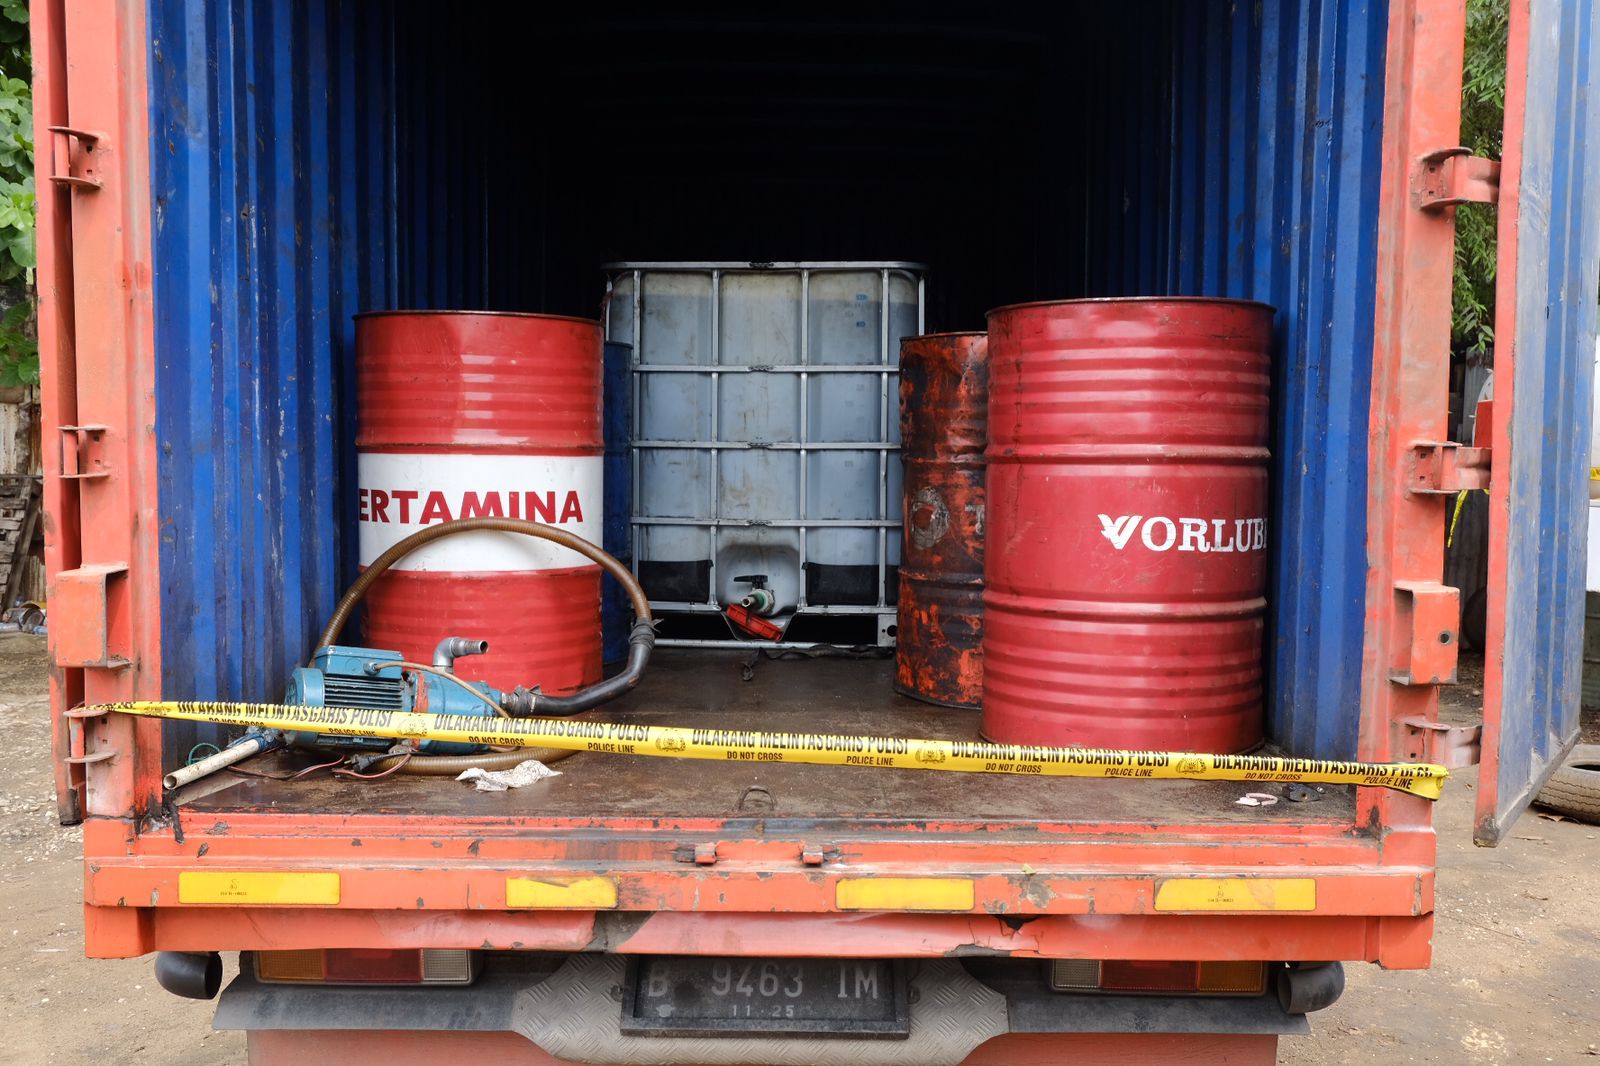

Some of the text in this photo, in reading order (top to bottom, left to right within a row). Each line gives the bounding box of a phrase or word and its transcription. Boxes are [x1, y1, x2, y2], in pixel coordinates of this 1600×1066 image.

[434, 714, 497, 733] DILARANG
[608, 723, 650, 742] POLISI
[468, 735, 525, 746] DO NOT CROSS
[692, 729, 756, 748] DILARANG
[867, 737, 908, 755] POLISI
[588, 742, 635, 753] POLICE LINE
[727, 751, 783, 760] DO NOT CROSS
[846, 755, 894, 766] POLICE LINE
[985, 762, 1042, 773] DO NOT CROSS
[1104, 767, 1153, 778] POLICE LINE
[1276, 773, 1303, 781] CROSS
[1363, 776, 1413, 789] POLICE LINE
[648, 961, 668, 997] B
[711, 962, 803, 997] 9463
